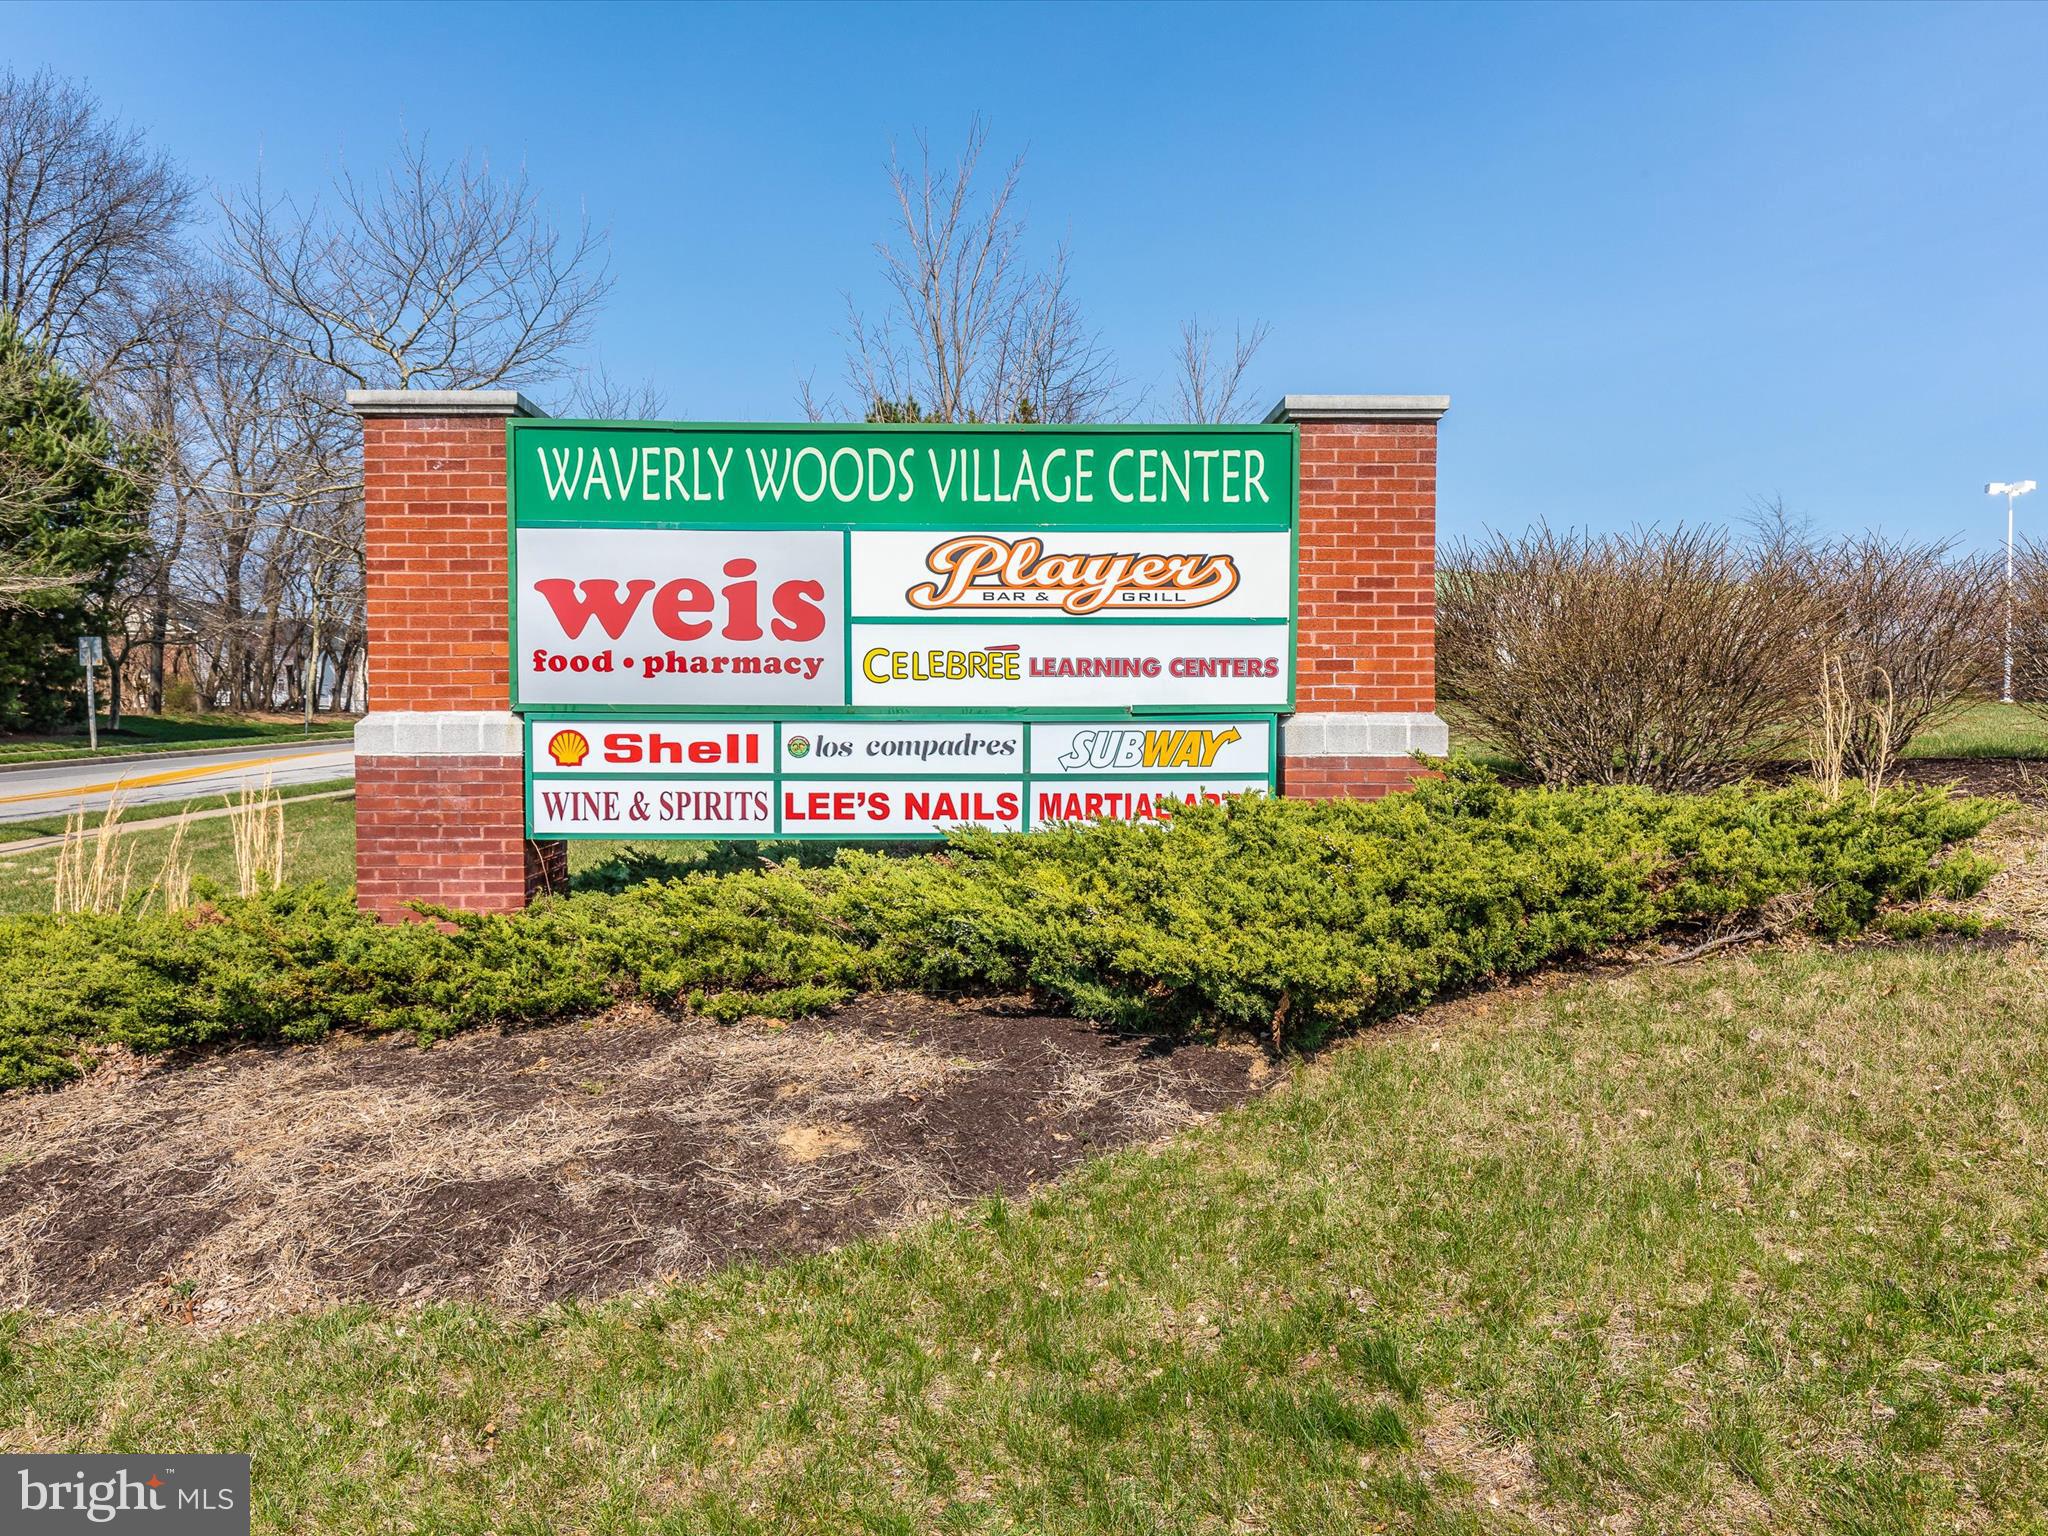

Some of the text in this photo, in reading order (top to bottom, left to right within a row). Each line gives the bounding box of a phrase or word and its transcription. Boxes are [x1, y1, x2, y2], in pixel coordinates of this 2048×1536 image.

[537, 447, 1270, 503] WAVERLY WOODS VILLAGE CENTER
[905, 535, 1241, 616] Players
[533, 558, 826, 641] weis
[982, 591, 1186, 602] BAR & GRILL
[532, 649, 824, 680] food pharmacy
[1029, 657, 1162, 679] LEARNING
[1168, 657, 1280, 679] CENTERS
[603, 733, 759, 764] Shell
[815, 732, 1017, 762] los compadres
[1057, 725, 1243, 772] SUBWAY
[542, 791, 768, 822] WINE & SPIRITS
[905, 792, 1019, 821] NAILS
[1038, 792, 1172, 821] MARTIAL
